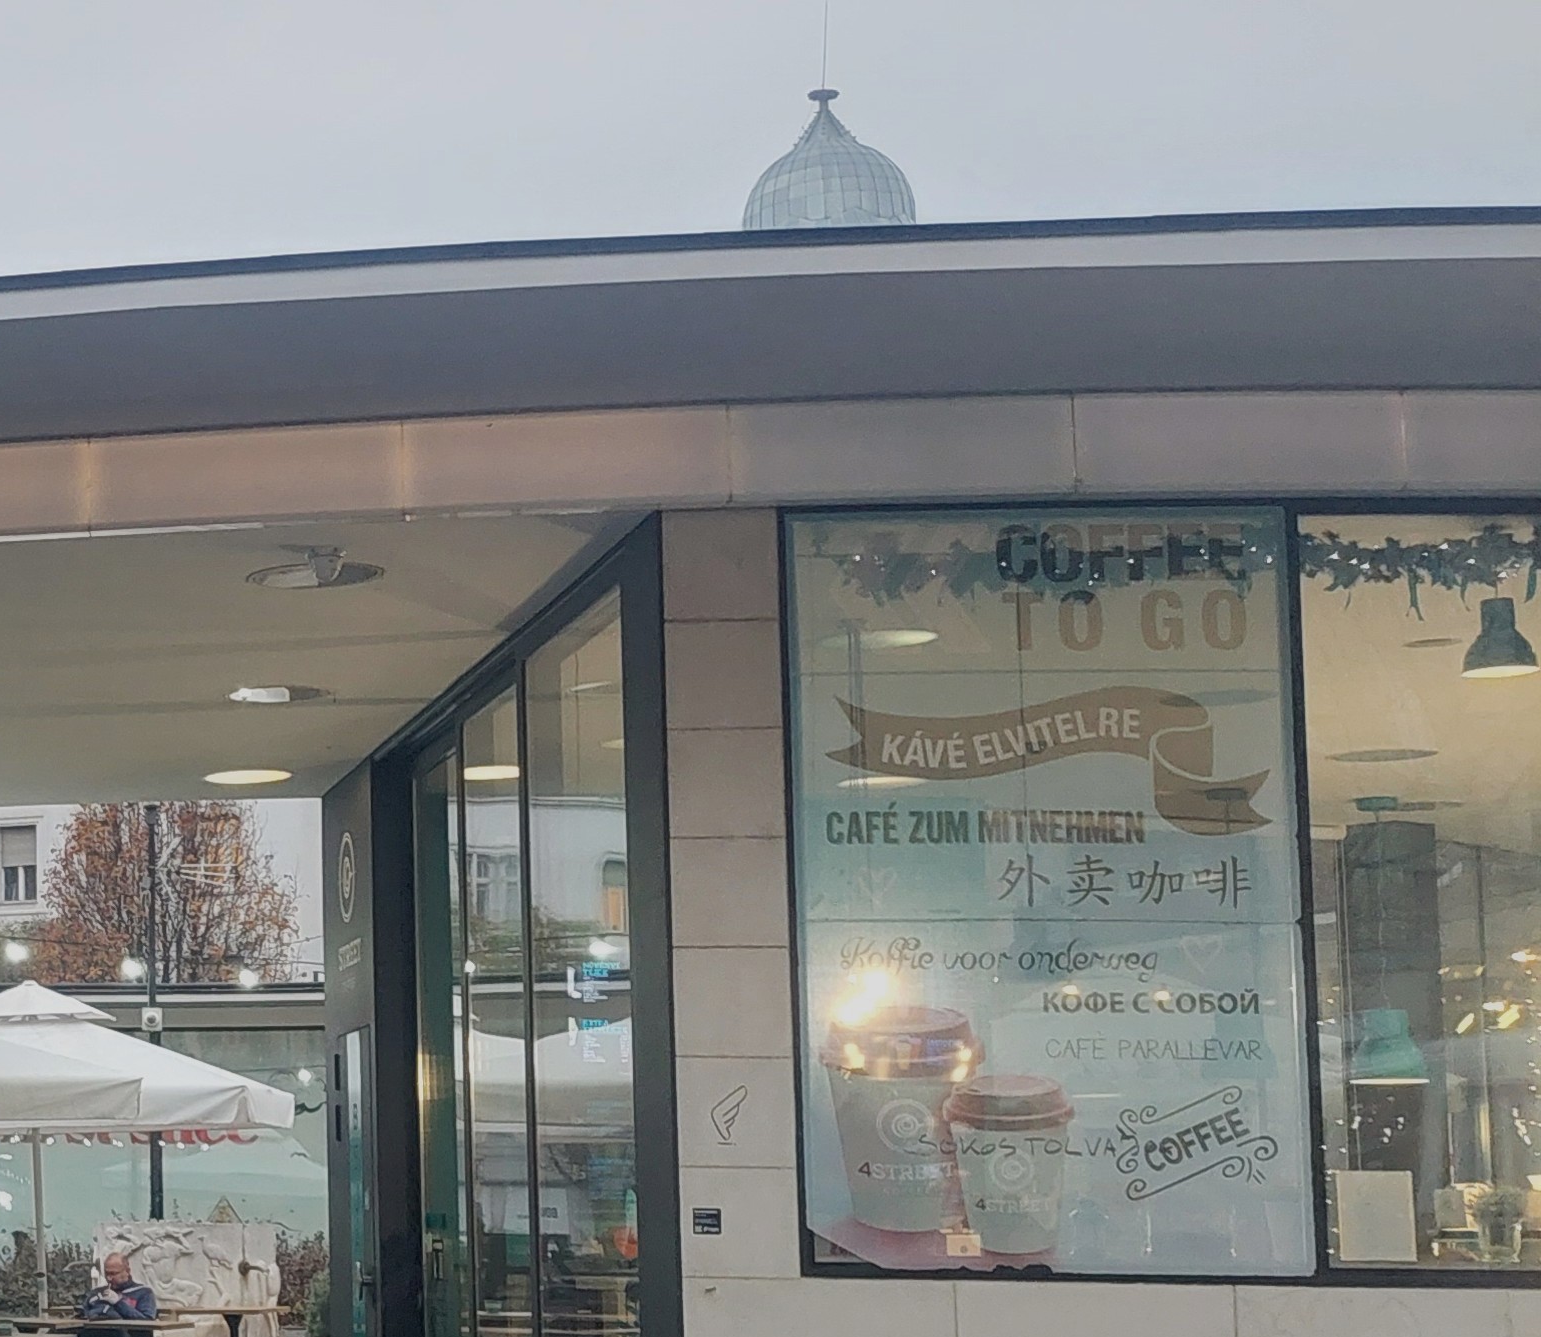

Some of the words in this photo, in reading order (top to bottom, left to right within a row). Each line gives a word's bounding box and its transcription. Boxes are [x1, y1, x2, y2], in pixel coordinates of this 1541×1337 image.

[995, 523, 1246, 583] COFFEE
[1002, 589, 1103, 651] TO
[1140, 589, 1247, 651] GO
[881, 730, 968, 768] KÁVÉ
[972, 707, 1141, 765] ELVITELRE
[825, 802, 900, 845] CAFÉ
[909, 810, 969, 845] ZUM
[978, 809, 1147, 845] MITNEHMEN
[997, 853, 1254, 909] 外卖咖啡
[840, 936, 935, 976] Koffie
[942, 949, 1014, 971] voor
[1017, 937, 1159, 984] onderweg
[1042, 990, 1125, 1014] КОФЕ
[1157, 988, 1260, 1015] СОБОЙ
[1144, 1107, 1251, 1172] COFFEE
